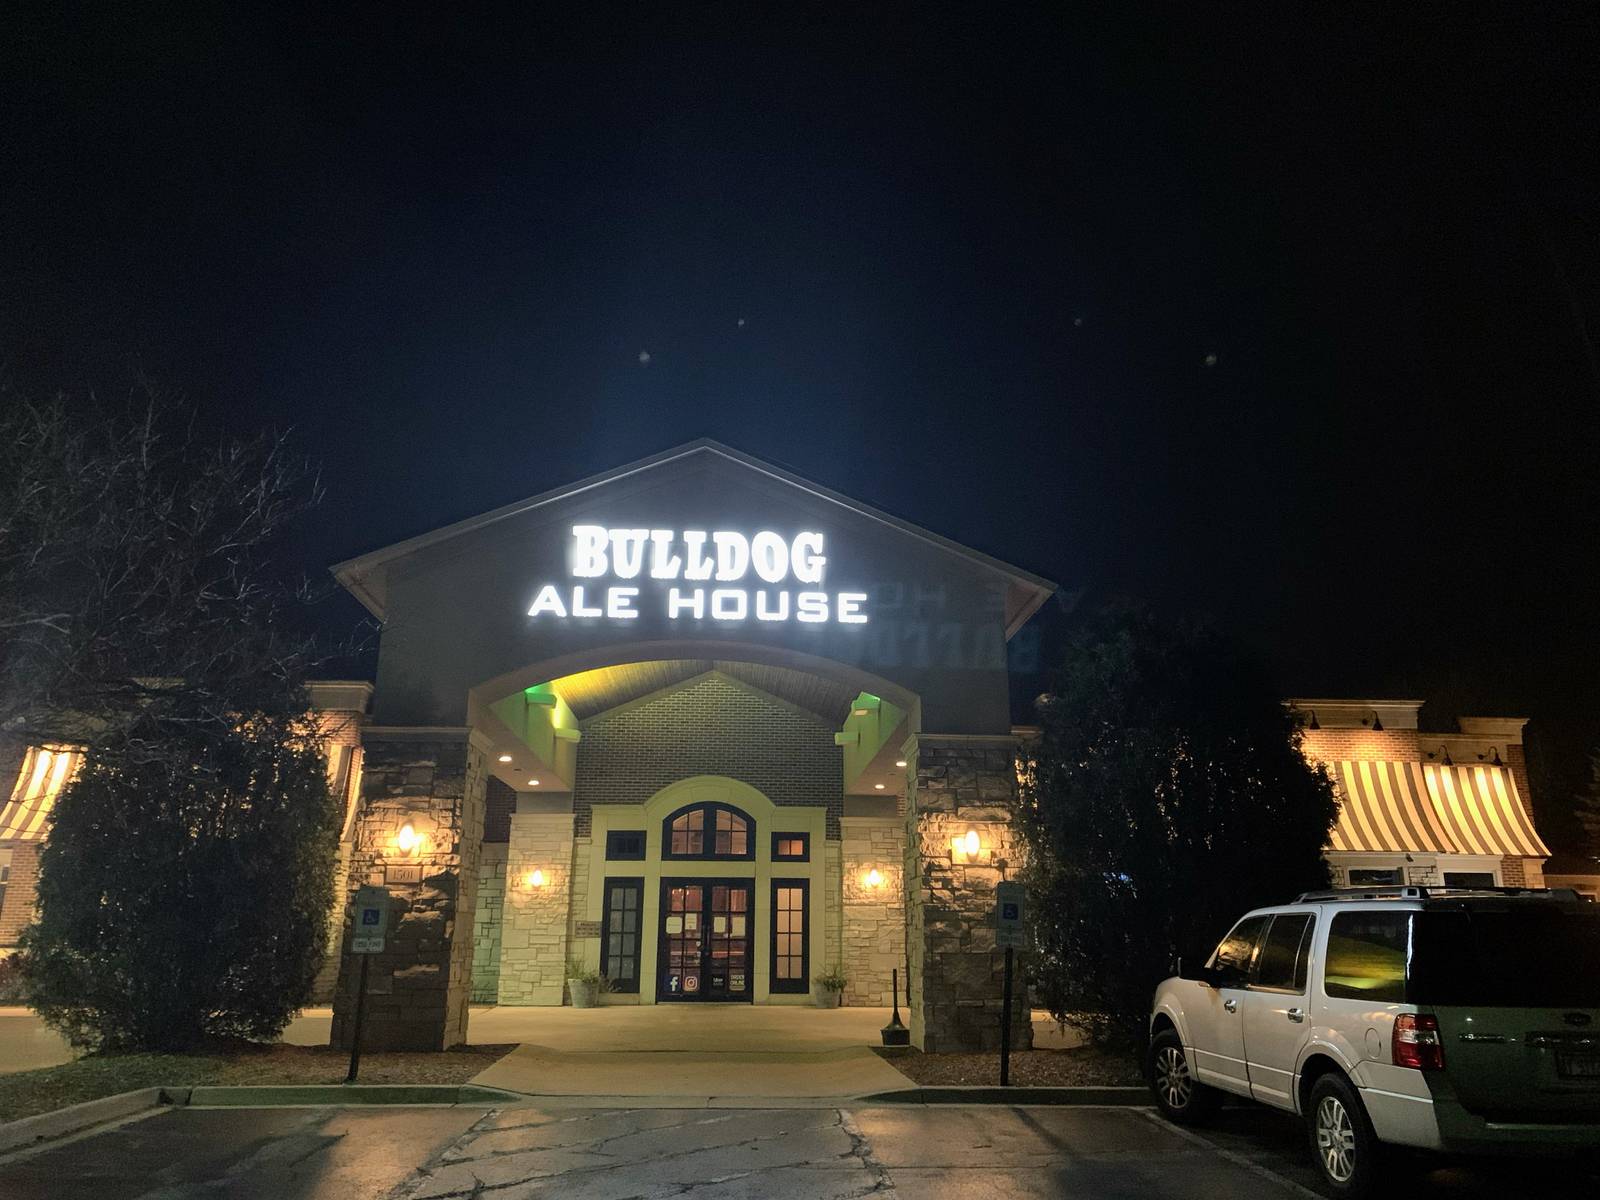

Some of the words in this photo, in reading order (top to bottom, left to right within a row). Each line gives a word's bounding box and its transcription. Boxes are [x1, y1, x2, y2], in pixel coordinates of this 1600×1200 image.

[572, 525, 826, 584] BULLDOG
[527, 585, 639, 619] ALE
[668, 588, 868, 624] HOUSE
